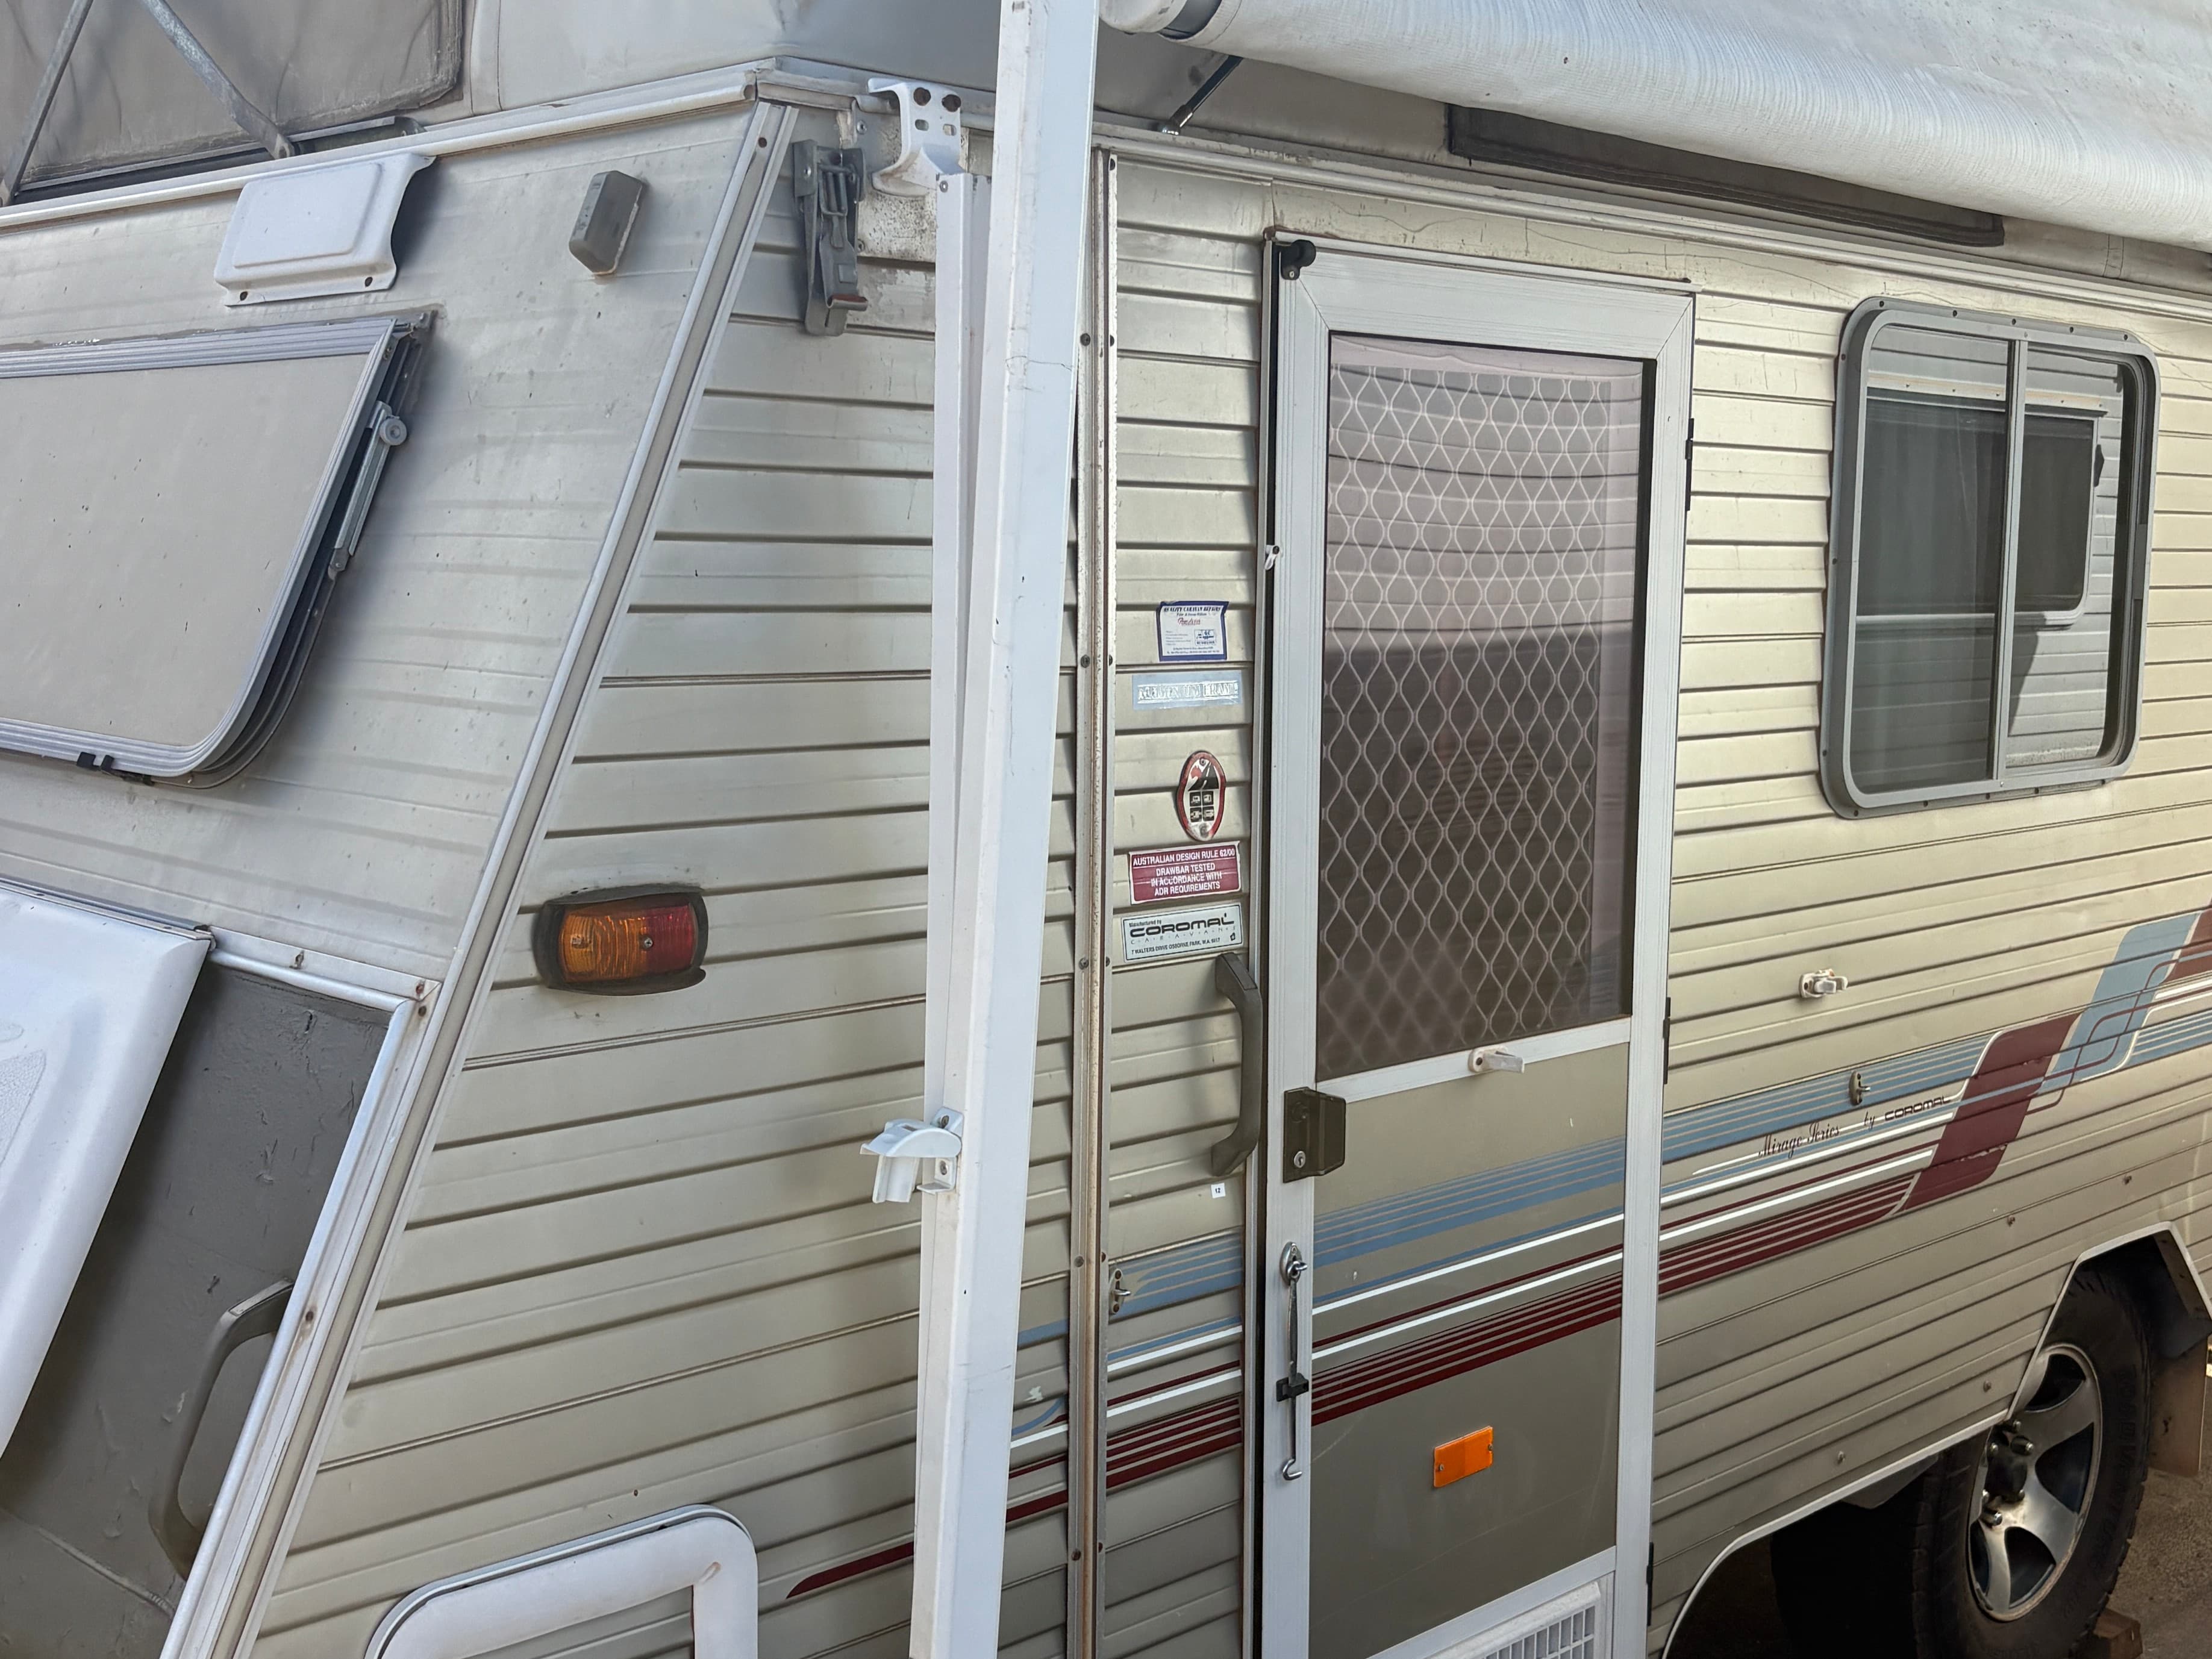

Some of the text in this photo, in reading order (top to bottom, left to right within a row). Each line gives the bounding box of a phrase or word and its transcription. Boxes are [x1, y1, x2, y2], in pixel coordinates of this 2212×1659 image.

[1133, 848, 1235, 866] AUSTRALIAN DESIGN RULE 62/00
[1156, 863, 1216, 876] DRAWBAR TESTED
[1151, 872, 1222, 887] IN ACCORDANCE WITH
[1155, 881, 1220, 896] ADR REQUIREMENTS
[1130, 914, 1234, 938] COROMAL
[1758, 1096, 1951, 1158] Mirage Series by COROMAL
